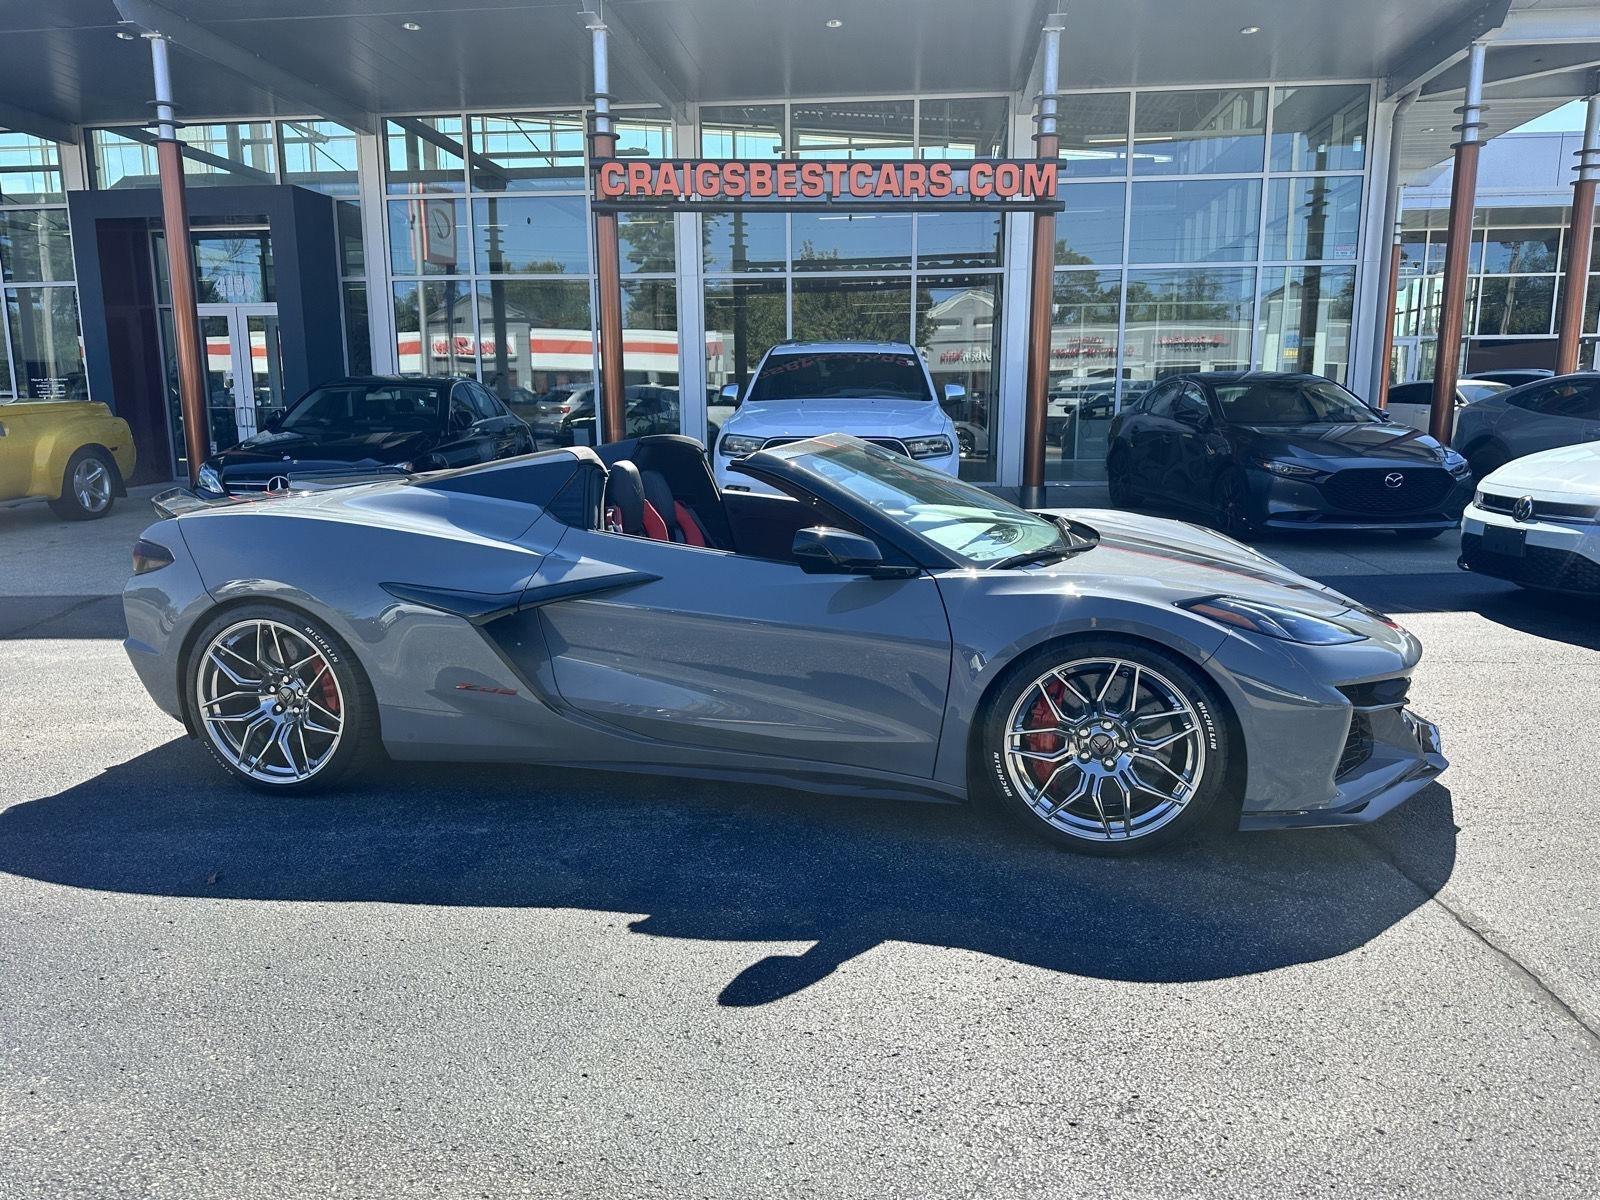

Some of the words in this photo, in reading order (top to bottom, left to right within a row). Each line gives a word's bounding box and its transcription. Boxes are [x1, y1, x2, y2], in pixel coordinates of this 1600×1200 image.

[600, 162, 1057, 198] CRAIGSBESTCARS.COM
[304, 626, 339, 663] MICHELIN
[1196, 701, 1217, 750] MICHELIN
[993, 751, 1013, 797] MICHELIN
